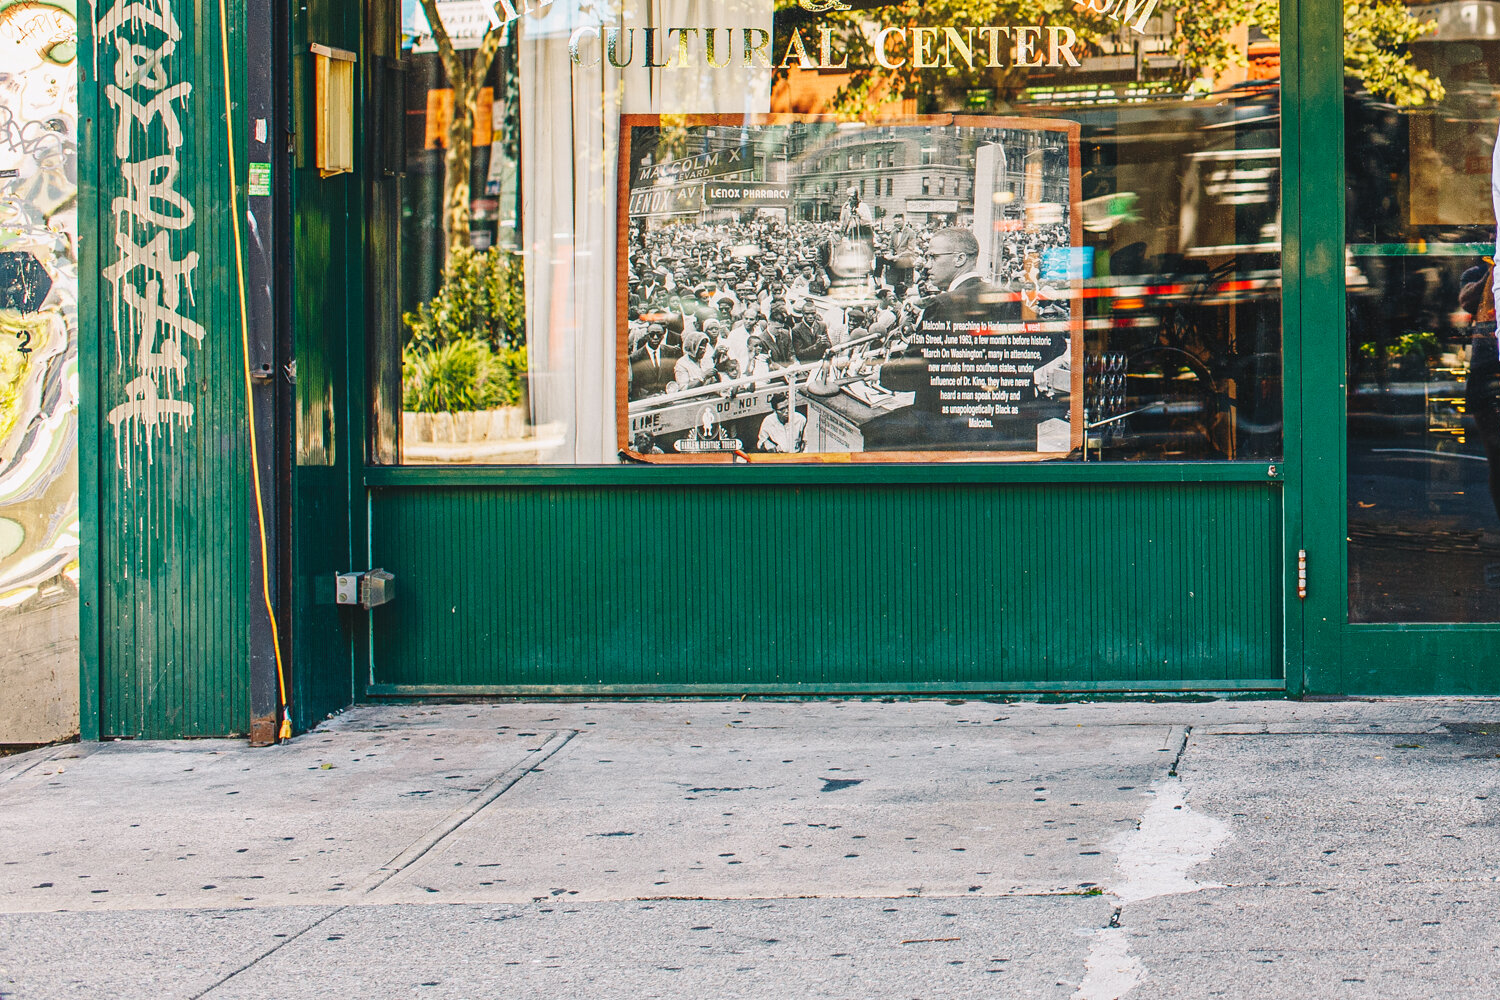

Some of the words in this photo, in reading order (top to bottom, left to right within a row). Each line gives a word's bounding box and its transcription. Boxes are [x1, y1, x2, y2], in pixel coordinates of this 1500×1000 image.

[567, 26, 849, 70] CULTURAL
[873, 25, 1082, 70] CENTER
[639, 152, 719, 181] MALCOLM
[728, 146, 741, 164] X
[628, 189, 672, 214] LENOX
[677, 186, 697, 200] AV
[710, 188, 741, 199] LENOX
[743, 188, 790, 200] PHARMACY
[922, 320, 946, 331] Malcolm
[953, 320, 980, 333] preaching
[925, 334, 943, 346] Street,
[944, 334, 958, 344] June
[959, 334, 973, 346] 1963,
[979, 334, 989, 345] few
[990, 335, 1011, 345] month's
[1012, 335, 1030, 346] before
[1030, 336, 1051, 346] historic
[941, 348, 950, 358] On
[988, 350, 1003, 361] many
[1004, 349, 1010, 358] in
[1010, 349, 1042, 360] attendance,
[928, 363, 940, 372] new
[940, 362, 961, 372] arrivals
[962, 362, 975, 372] from
[999, 363, 1017, 374] states,
[1017, 363, 1034, 373] under
[930, 376, 955, 386] influence
[956, 376, 963, 386] of
[963, 376, 972, 386] Dr.
[987, 377, 1000, 389] they
[1000, 377, 1014, 387] have
[1014, 378, 1030, 387] never
[940, 390, 956, 400] heard
[961, 391, 974, 400] man
[974, 391, 991, 402] speak
[991, 391, 1009, 402] boldly
[1009, 391, 1020, 400] and
[716, 402, 731, 413] DO
[738, 396, 759, 408] NOT
[941, 405, 949, 414] as
[949, 404, 994, 416] unapologetically
[995, 404, 1011, 414] Black
[1011, 406, 1018, 415] as
[632, 413, 661, 432] LINE
[968, 418, 993, 428] Malcolm.
